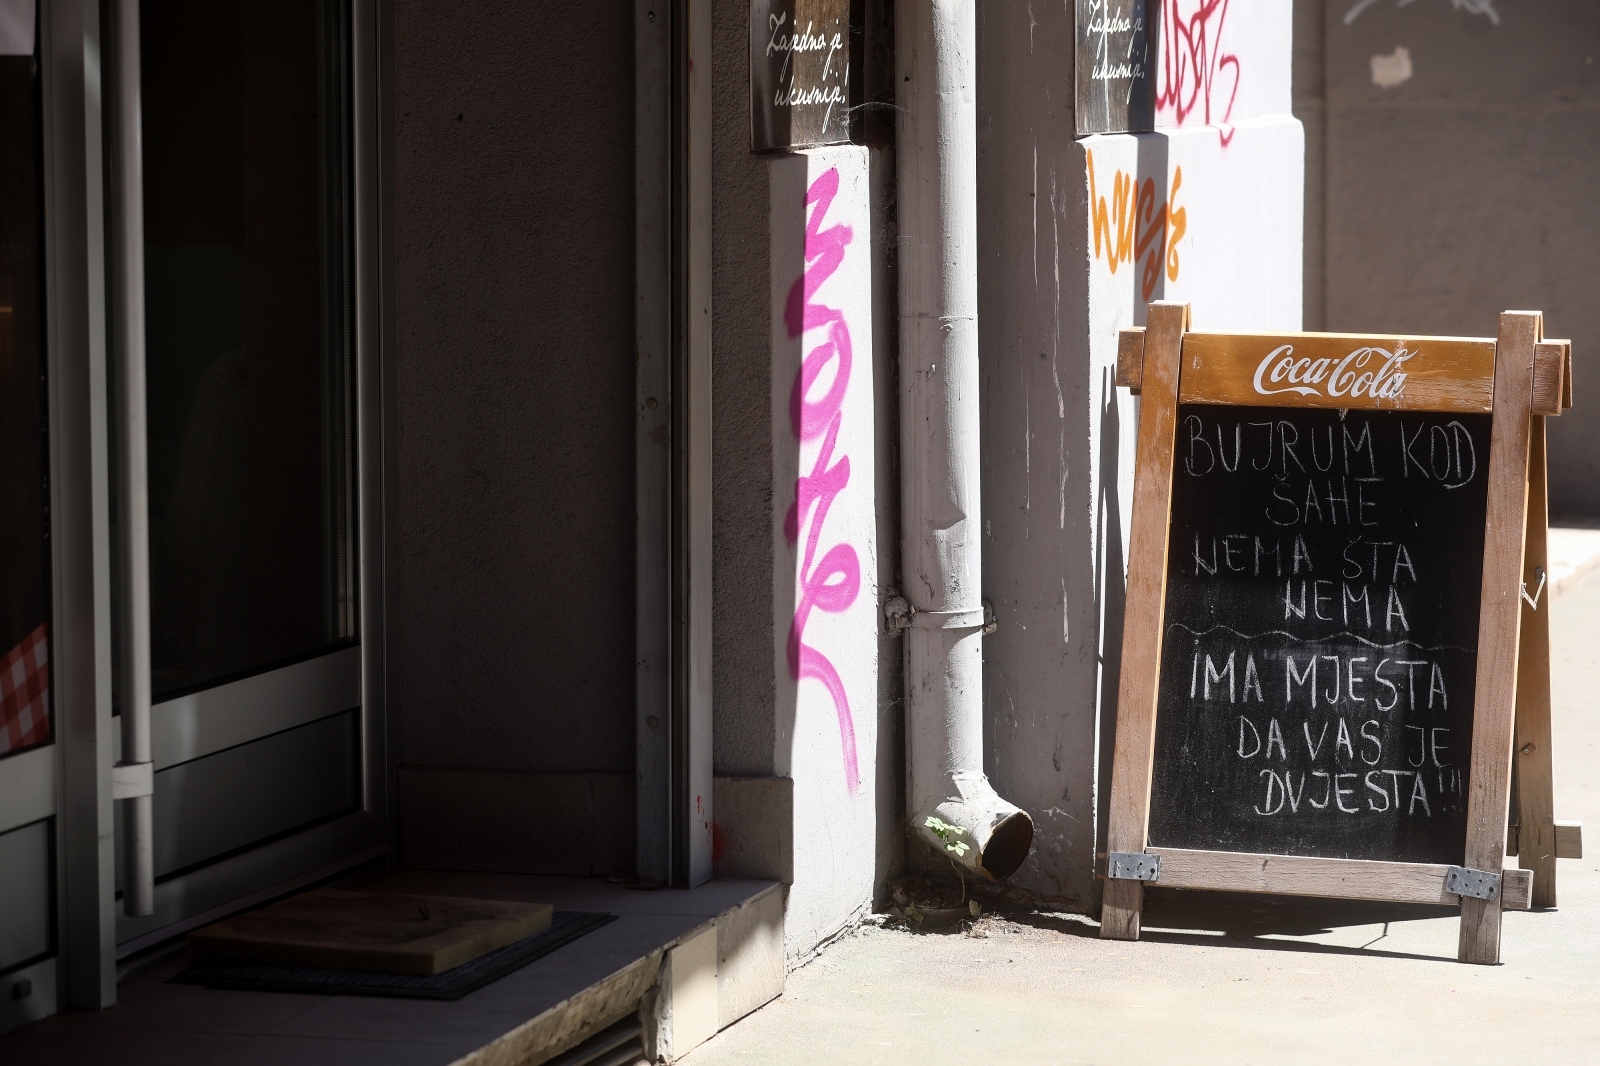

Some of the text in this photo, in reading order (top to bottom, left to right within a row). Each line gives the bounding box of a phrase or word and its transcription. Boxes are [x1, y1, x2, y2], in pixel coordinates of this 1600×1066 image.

[822, 18, 843, 82] je
[1253, 344, 1419, 399] Coca-Cola
[1184, 414, 1476, 489] BUJRUM KOD
[1265, 473, 1384, 526] ŠAHE
[1191, 530, 1417, 583] NEMA ŠTA
[1284, 579, 1411, 633] NEMA
[1190, 639, 1448, 712] IMA MJESTA
[1236, 715, 1451, 768] DA VAS JE
